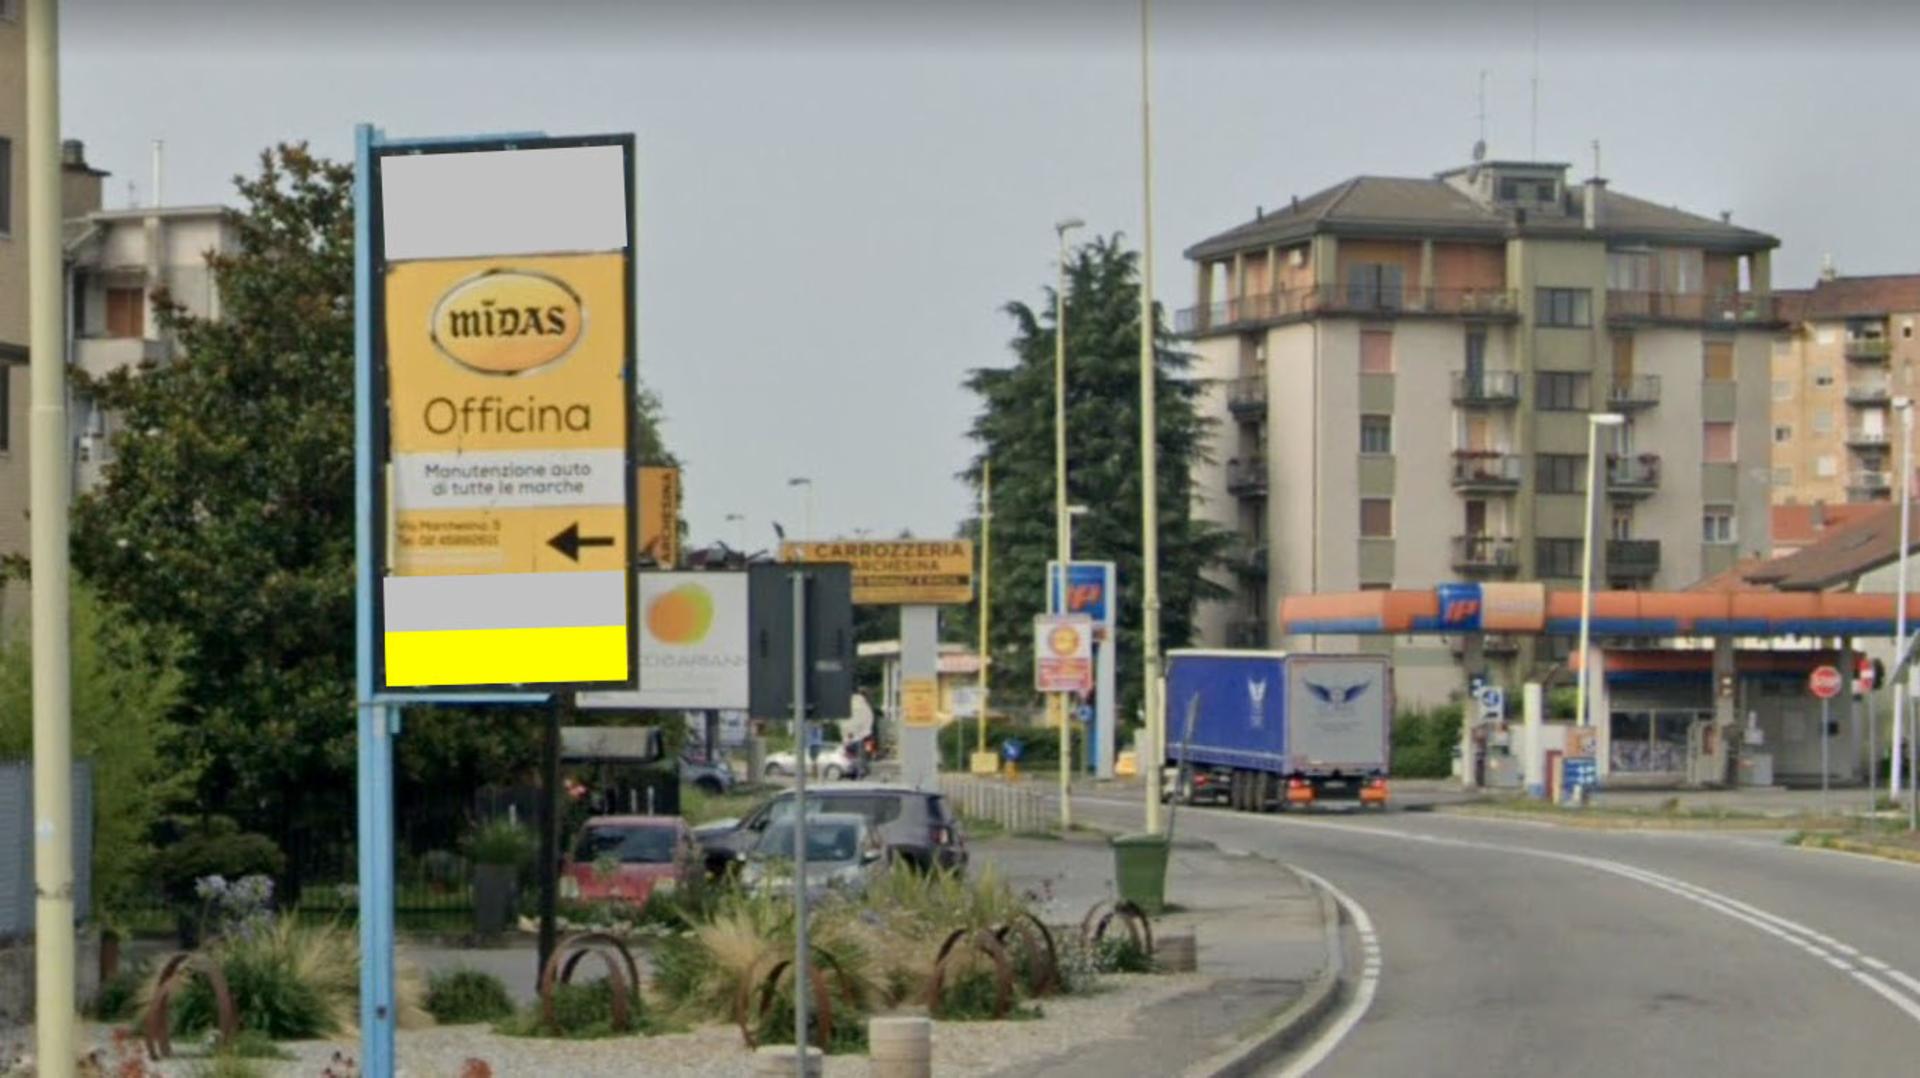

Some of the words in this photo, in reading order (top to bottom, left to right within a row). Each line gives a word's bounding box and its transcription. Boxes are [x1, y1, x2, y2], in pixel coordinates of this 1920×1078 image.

[424, 396, 590, 434] Officina
[425, 463, 546, 479] Manutenzione
[551, 464, 591, 477] auto
[432, 482, 447, 496] di
[451, 482, 493, 495] tutte
[498, 481, 514, 494] le
[518, 480, 583, 494] marche
[661, 472, 673, 563] ARCHESINA
[815, 542, 965, 558] CARROZZERIA
[851, 559, 940, 571] ARCHESINA
[1448, 601, 1479, 622] IP
